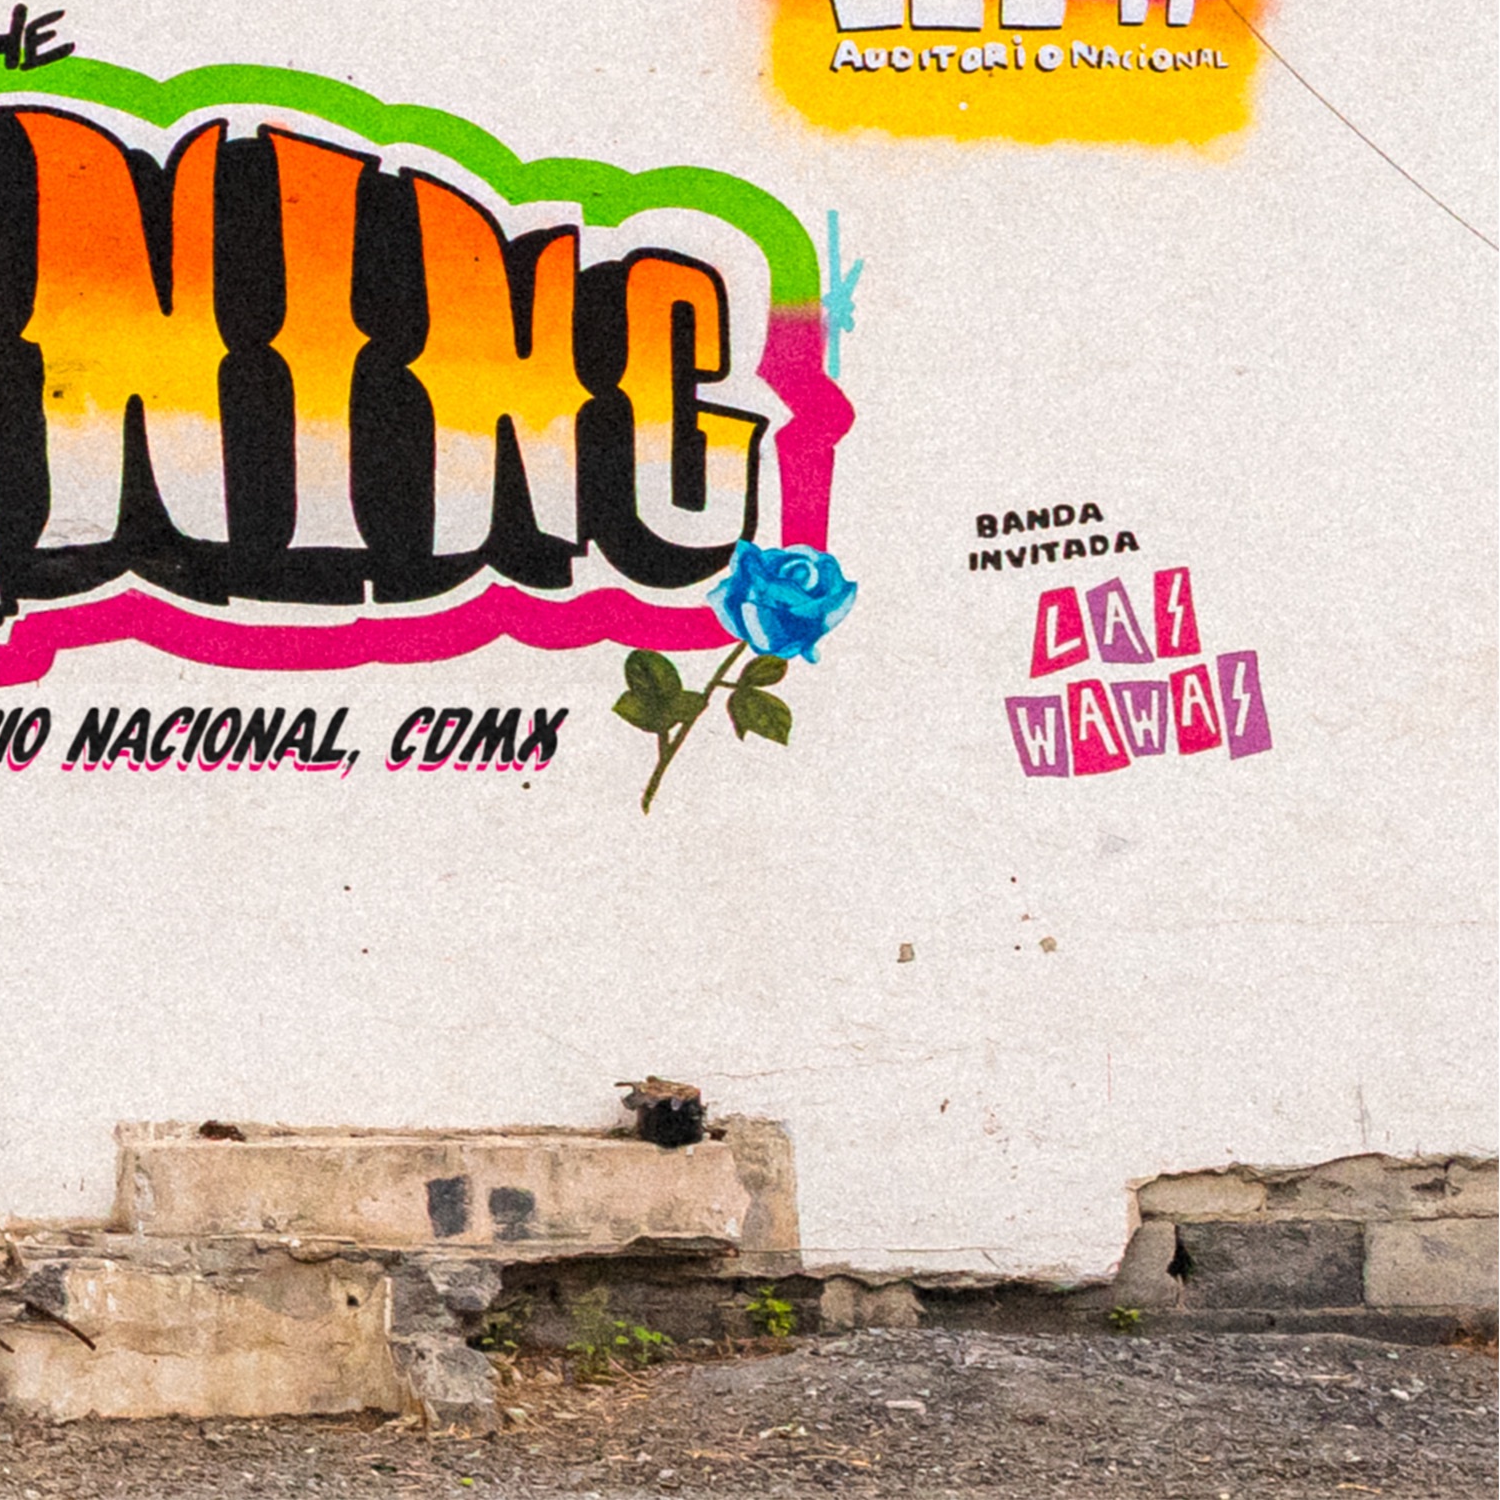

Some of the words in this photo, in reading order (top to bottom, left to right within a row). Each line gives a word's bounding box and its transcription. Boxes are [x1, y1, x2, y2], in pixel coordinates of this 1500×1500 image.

[969, 531, 1140, 571] INVITADA
[976, 502, 1104, 538] BANDA
[1043, 571, 1186, 662] LAS
[61, 706, 360, 780] NACIONAL,
[385, 707, 569, 772] CDMX
[1013, 659, 1255, 768] WAWAS
